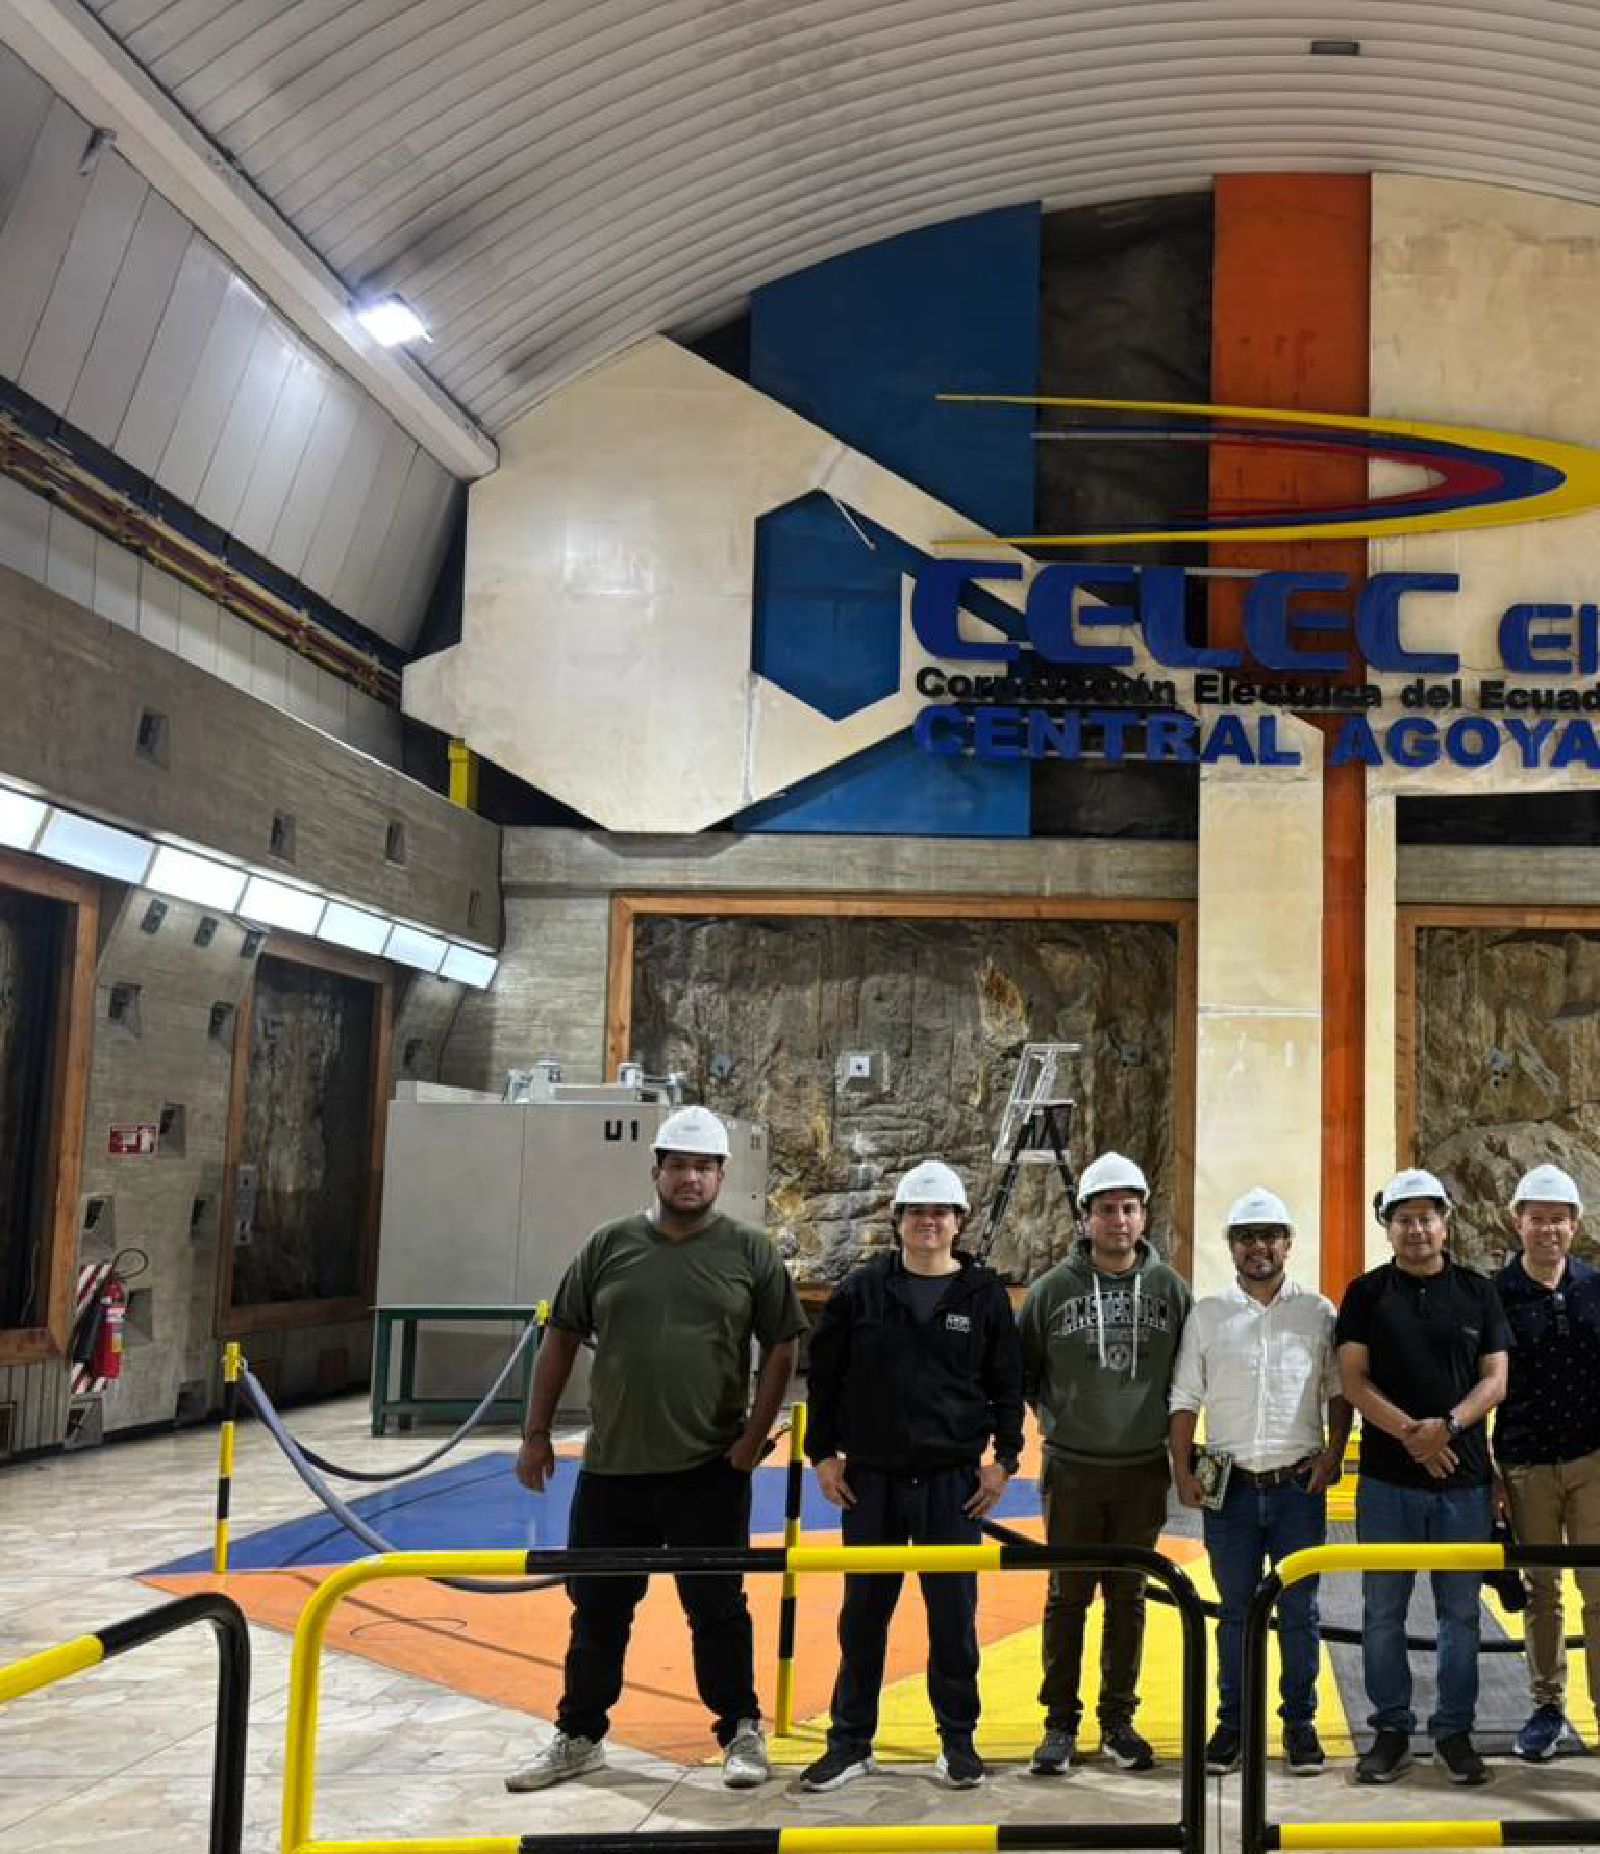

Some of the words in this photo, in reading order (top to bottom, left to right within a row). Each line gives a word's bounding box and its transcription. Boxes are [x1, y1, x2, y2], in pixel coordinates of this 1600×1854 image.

[909, 558, 1460, 676] CELEC
[1401, 678, 1461, 709] del
[914, 704, 1301, 767] CENTRAL
